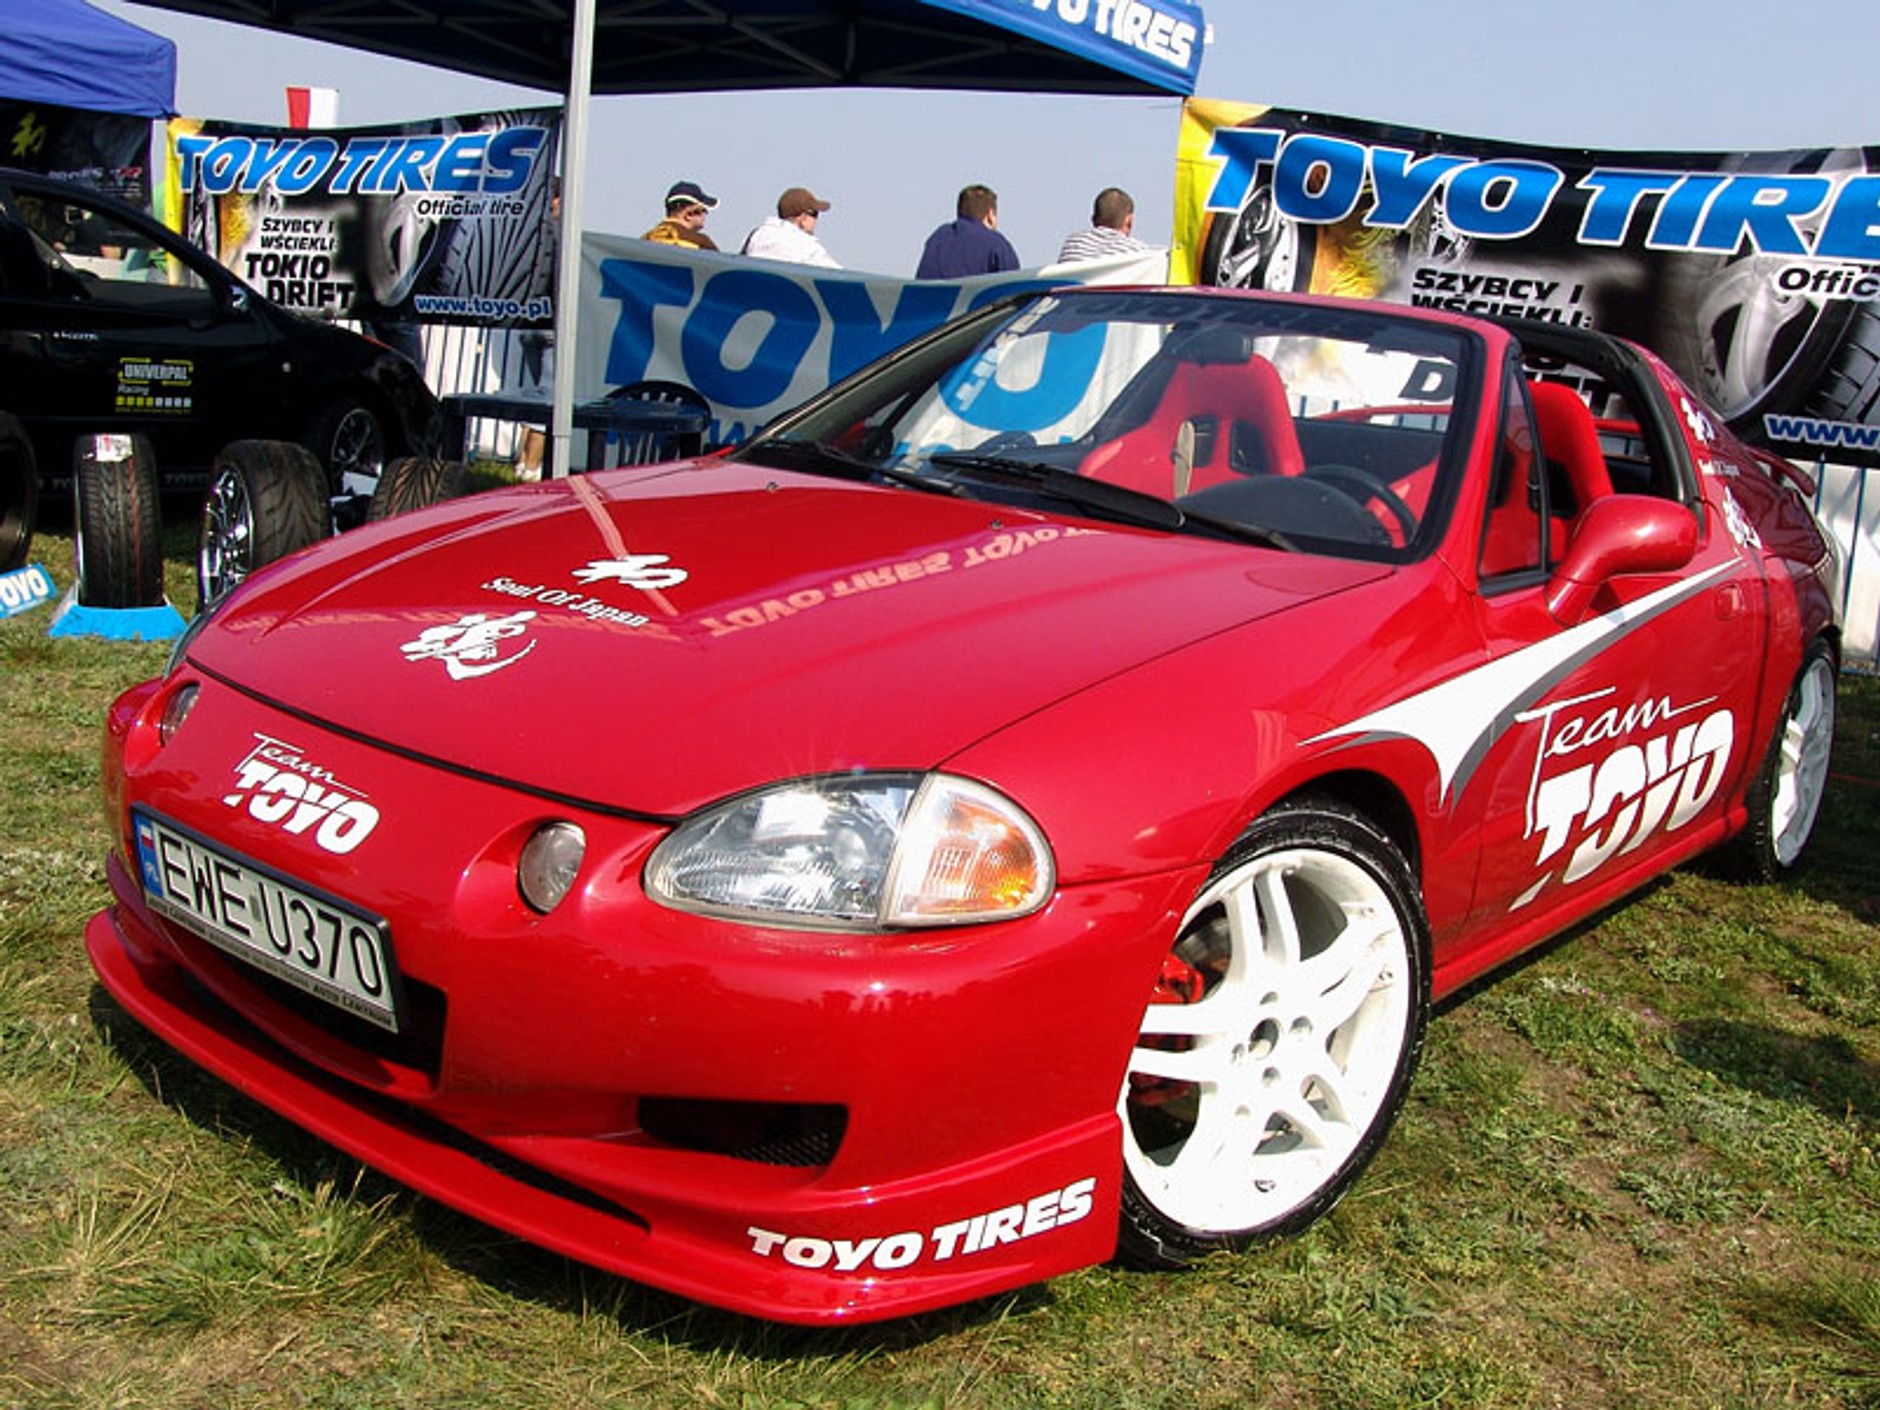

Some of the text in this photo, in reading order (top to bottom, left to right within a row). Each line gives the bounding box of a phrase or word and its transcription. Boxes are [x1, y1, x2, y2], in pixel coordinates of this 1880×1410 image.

[1095, 0, 1196, 69] TIRES
[176, 136, 340, 194] TOYO
[329, 125, 550, 195] TIRES
[1204, 127, 1566, 240] TOYO
[261, 217, 323, 234] SZYBCY
[416, 198, 486, 216] Official
[245, 252, 331, 279] TOKIO
[267, 280, 354, 309] DRIFT
[1412, 267, 1561, 301] SZYBCY
[415, 295, 550, 318] www.toyo.pl
[568, 598, 649, 628] Japan
[234, 732, 368, 798] Team
[1513, 686, 1718, 841] Team
[222, 759, 381, 855] TOYO
[1508, 709, 1735, 913] TOYO
[158, 831, 253, 937] EWE
[258, 882, 384, 998] U370
[747, 1176, 1097, 1271] TOYO TIRES
